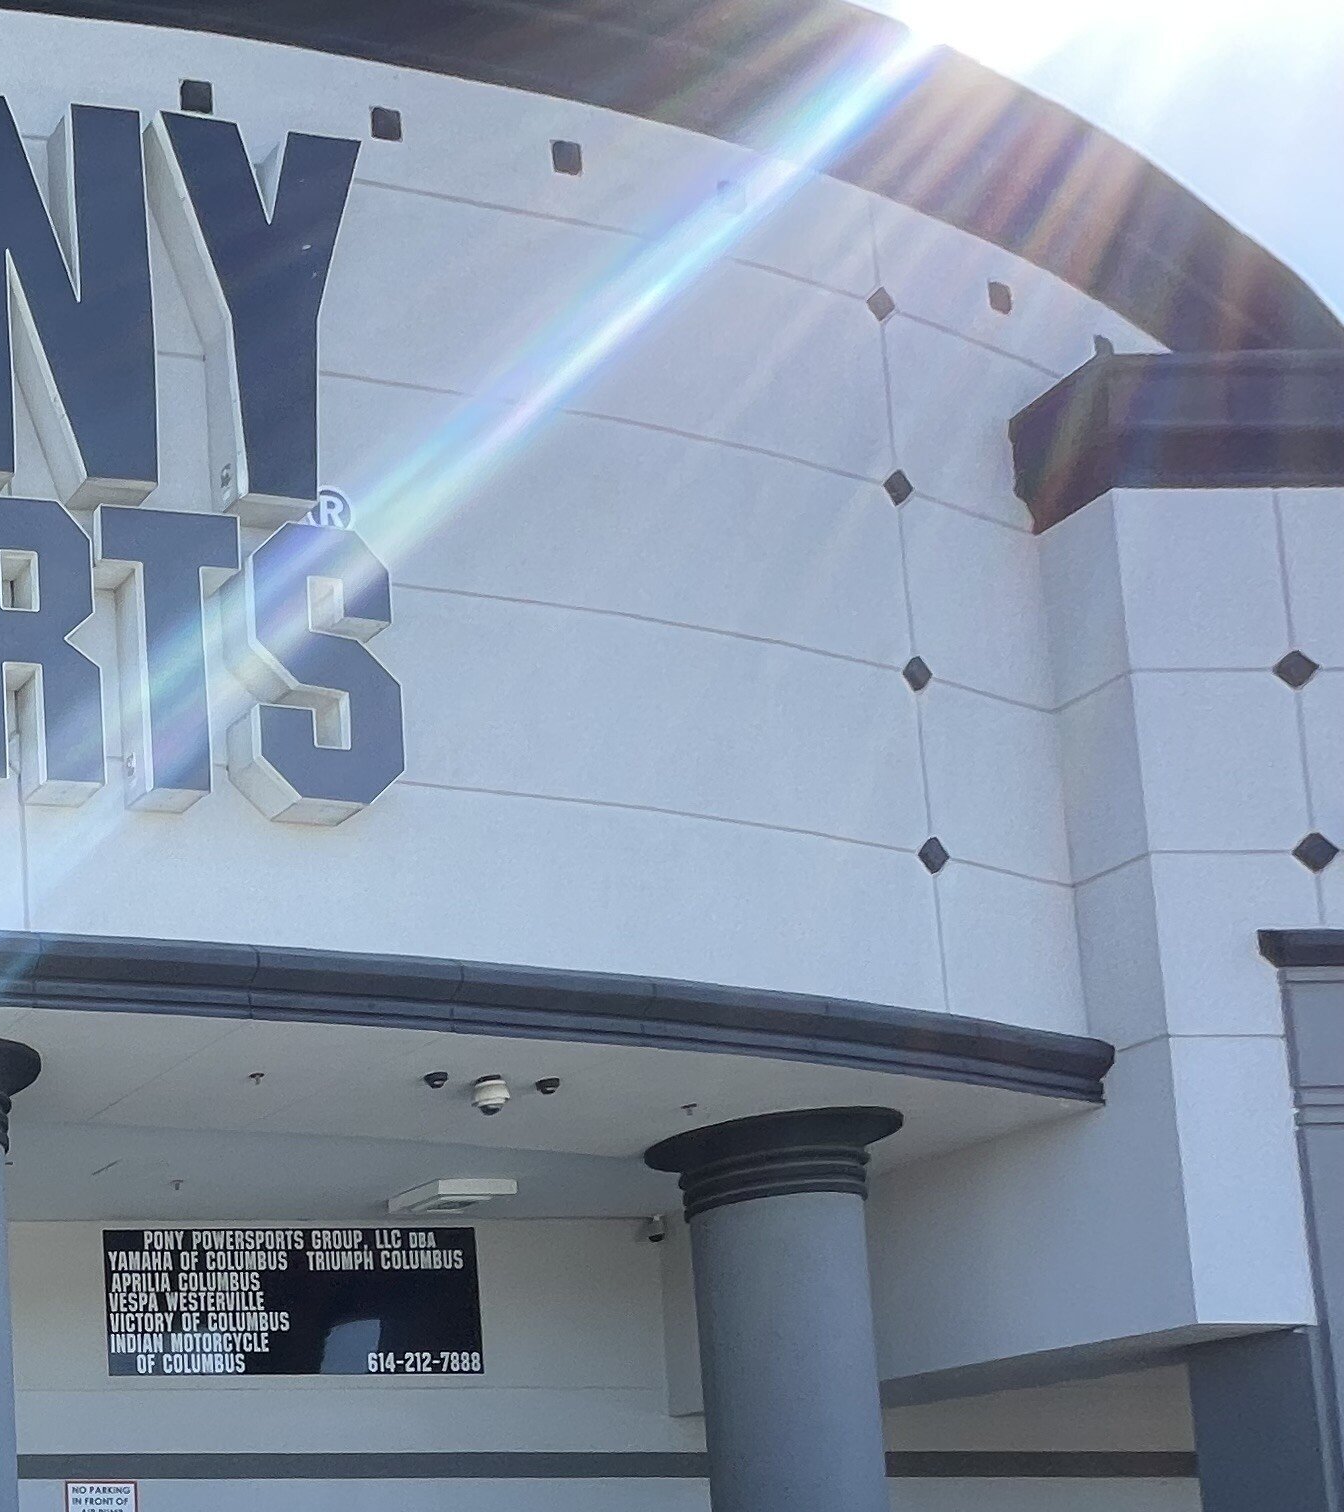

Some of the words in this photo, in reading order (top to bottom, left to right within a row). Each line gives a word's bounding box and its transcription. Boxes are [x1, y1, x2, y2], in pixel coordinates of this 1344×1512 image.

[143, 1230, 184, 1250] PONY
[192, 1230, 304, 1250] POWERSPORTS
[312, 1229, 368, 1250] GROUP,
[375, 1229, 402, 1249] LLC
[409, 1231, 437, 1249] DBA
[107, 1250, 173, 1271] YAMAHA
[179, 1250, 199, 1271] OF
[205, 1250, 288, 1271] COLUMBUS
[306, 1250, 375, 1271] TRIUMPH
[380, 1249, 464, 1270] COLUMBUS
[111, 1272, 171, 1292] APRILIA
[178, 1271, 261, 1292] COLUMBUS
[108, 1292, 159, 1312] VESPA
[165, 1291, 265, 1312] WESTERVILLE
[109, 1312, 174, 1333] VICTORY
[181, 1312, 201, 1332] OF
[207, 1311, 290, 1332] COLUMBUS
[110, 1333, 163, 1354] INDIAN
[170, 1332, 270, 1353] MOTORCYCLE
[136, 1354, 156, 1374] OF
[162, 1353, 246, 1374] COLUMBUS
[367, 1352, 482, 1373] 614-212-7888
[72, 1486, 87, 1495] NO
[89, 1486, 131, 1495] PARKING
[72, 1497, 82, 1506] IN
[84, 1497, 114, 1506] FRONT
[115, 1497, 129, 1506] OF
